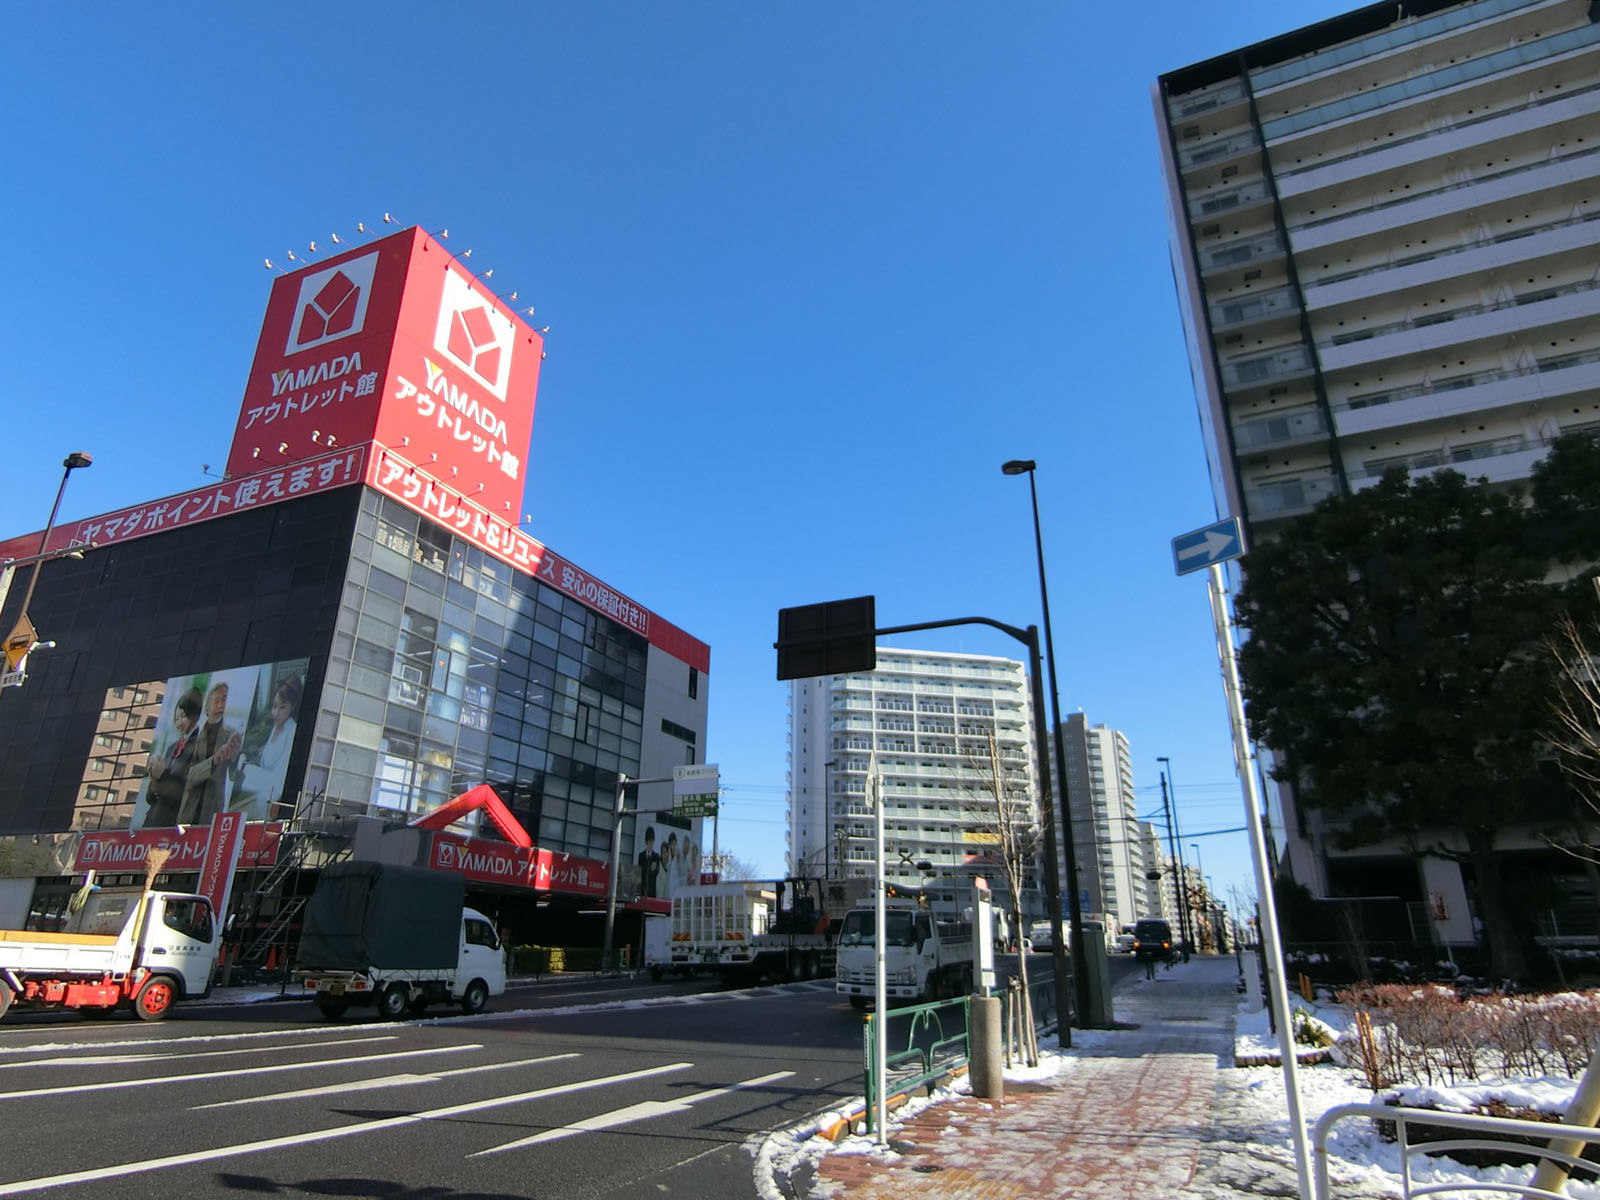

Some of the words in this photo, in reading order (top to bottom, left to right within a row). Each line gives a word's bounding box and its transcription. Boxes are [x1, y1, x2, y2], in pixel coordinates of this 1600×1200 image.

[244, 371, 378, 430] アウトレット館
[271, 352, 362, 397] YAMADA
[424, 356, 508, 444] YAMADA
[395, 375, 519, 479] アウトレット館
[98, 841, 153, 862] YAMADA
[456, 845, 514, 876] YAMADA
[516, 858, 589, 887] アウトレット館
